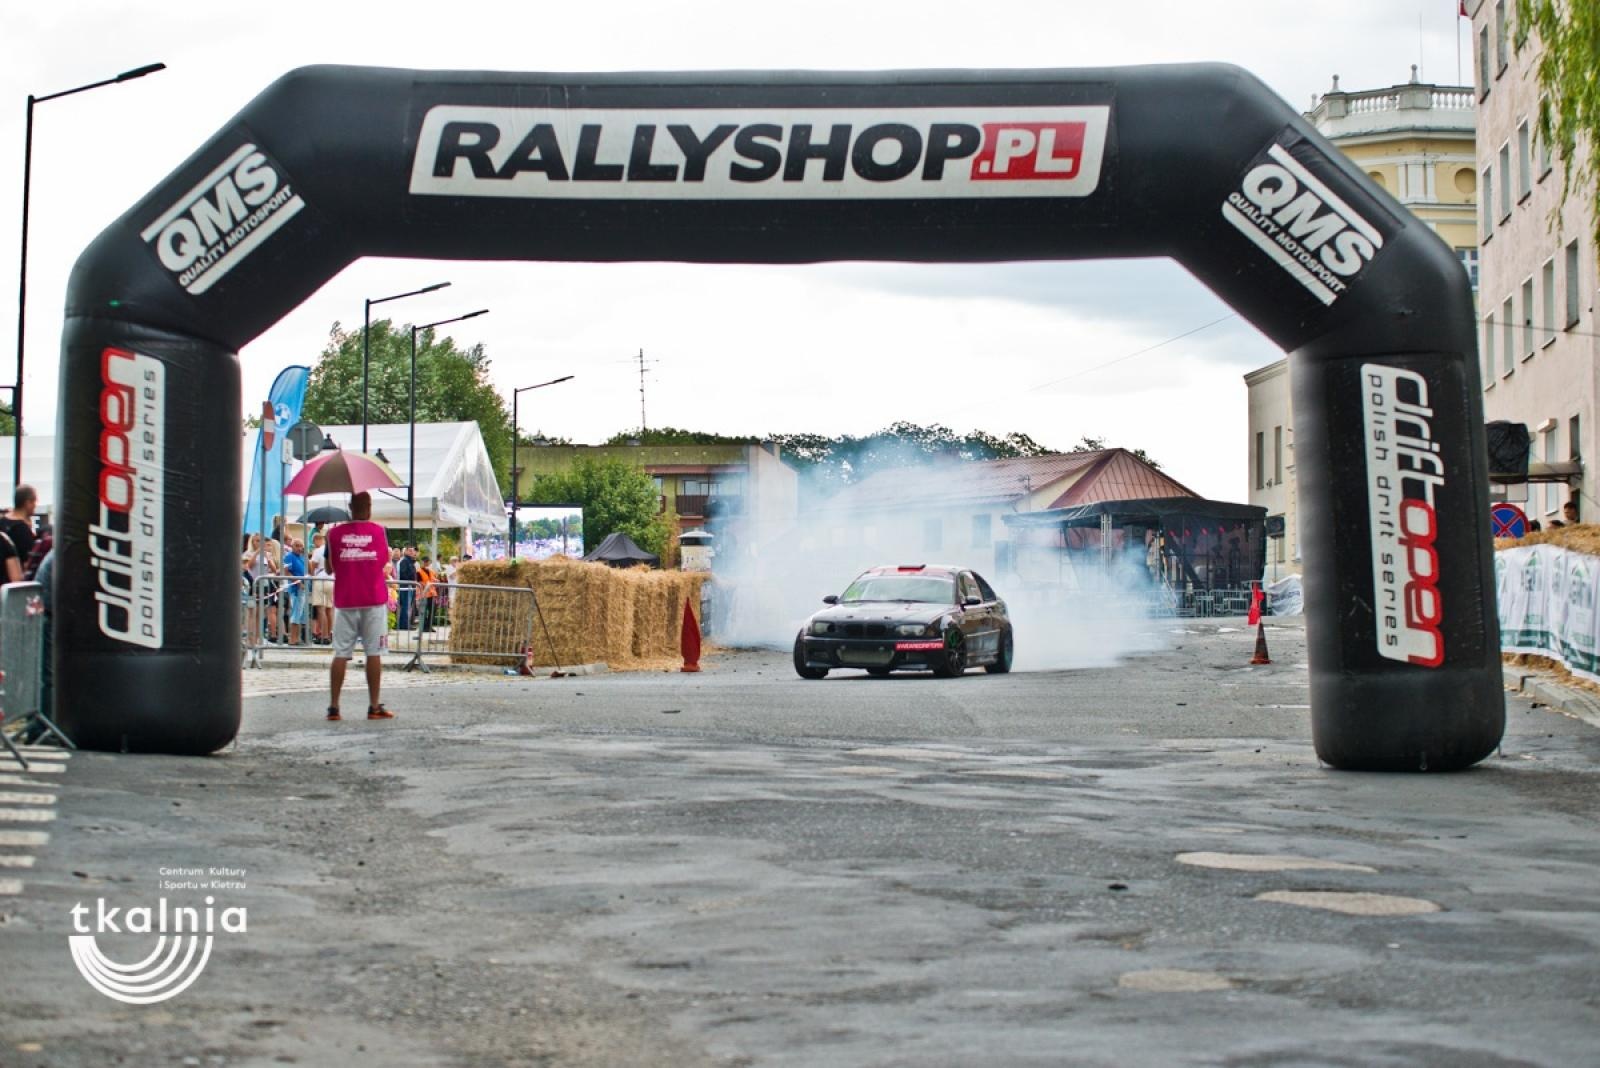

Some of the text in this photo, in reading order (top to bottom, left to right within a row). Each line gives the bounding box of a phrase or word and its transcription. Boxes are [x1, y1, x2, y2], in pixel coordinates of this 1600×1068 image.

[433, 122, 1073, 182] RALLYSHOP.PL
[157, 152, 278, 272] QMS
[178, 184, 292, 287] QUALITY MOTOSPORT
[1228, 192, 1346, 292] QUALITY MOTOSPORT
[1242, 163, 1375, 276] QMS
[139, 369, 157, 639] polish drift series
[1368, 374, 1398, 646] polish drift series
